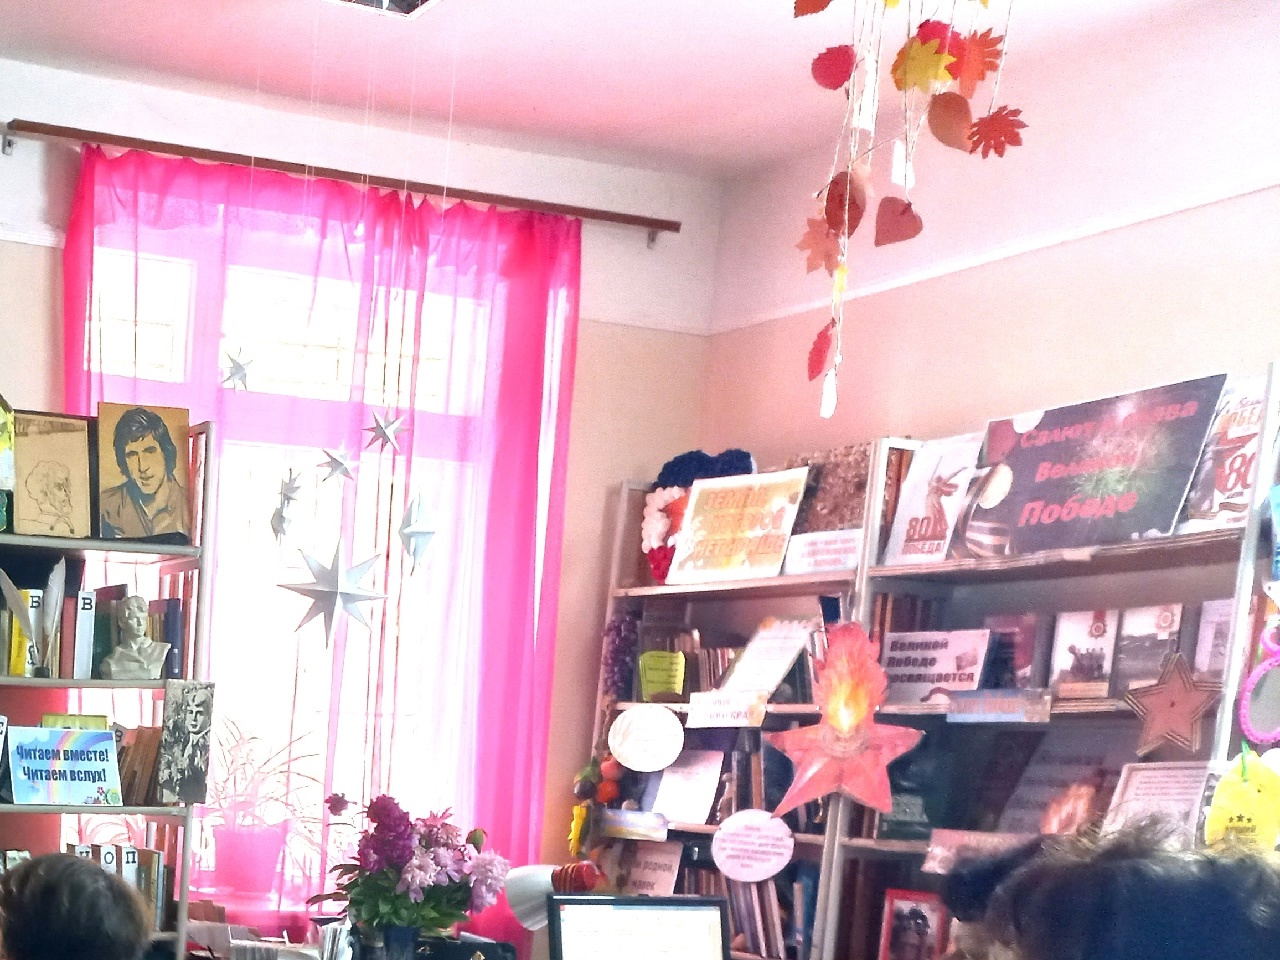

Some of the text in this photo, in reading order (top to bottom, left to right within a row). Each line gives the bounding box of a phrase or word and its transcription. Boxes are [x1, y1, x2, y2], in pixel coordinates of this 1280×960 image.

[1017, 490, 1138, 528] Победе
[29, 595, 41, 609] Б
[81, 597, 93, 611] В
[17, 745, 110, 762] Читаем вместе!
[23, 766, 107, 783] Читаем вслух!
[125, 850, 137, 864] П
